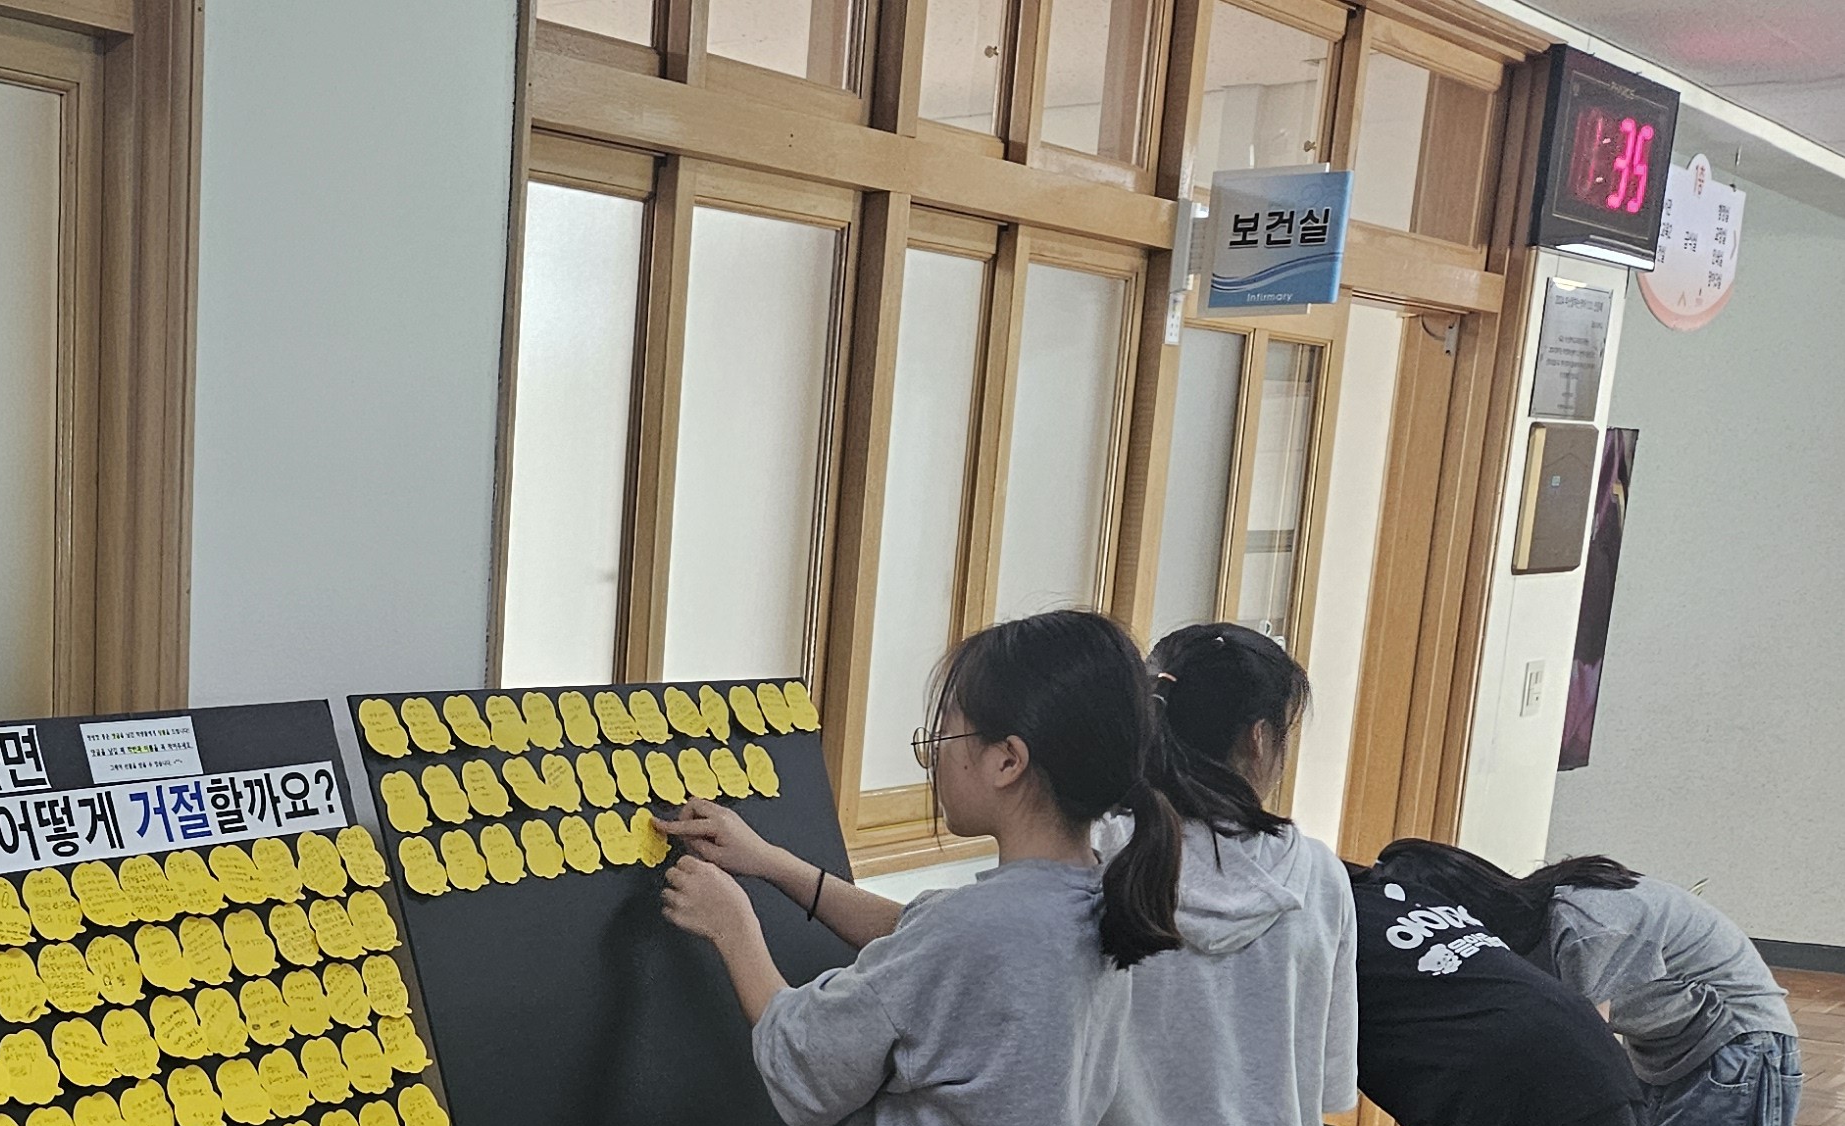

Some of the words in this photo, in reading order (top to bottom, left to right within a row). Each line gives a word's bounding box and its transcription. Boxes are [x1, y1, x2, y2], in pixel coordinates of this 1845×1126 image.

[1228, 207, 1332, 248] 보건실
[1247, 292, 1294, 302] Infirmary
[129, 767, 336, 844] 거절할까요?
